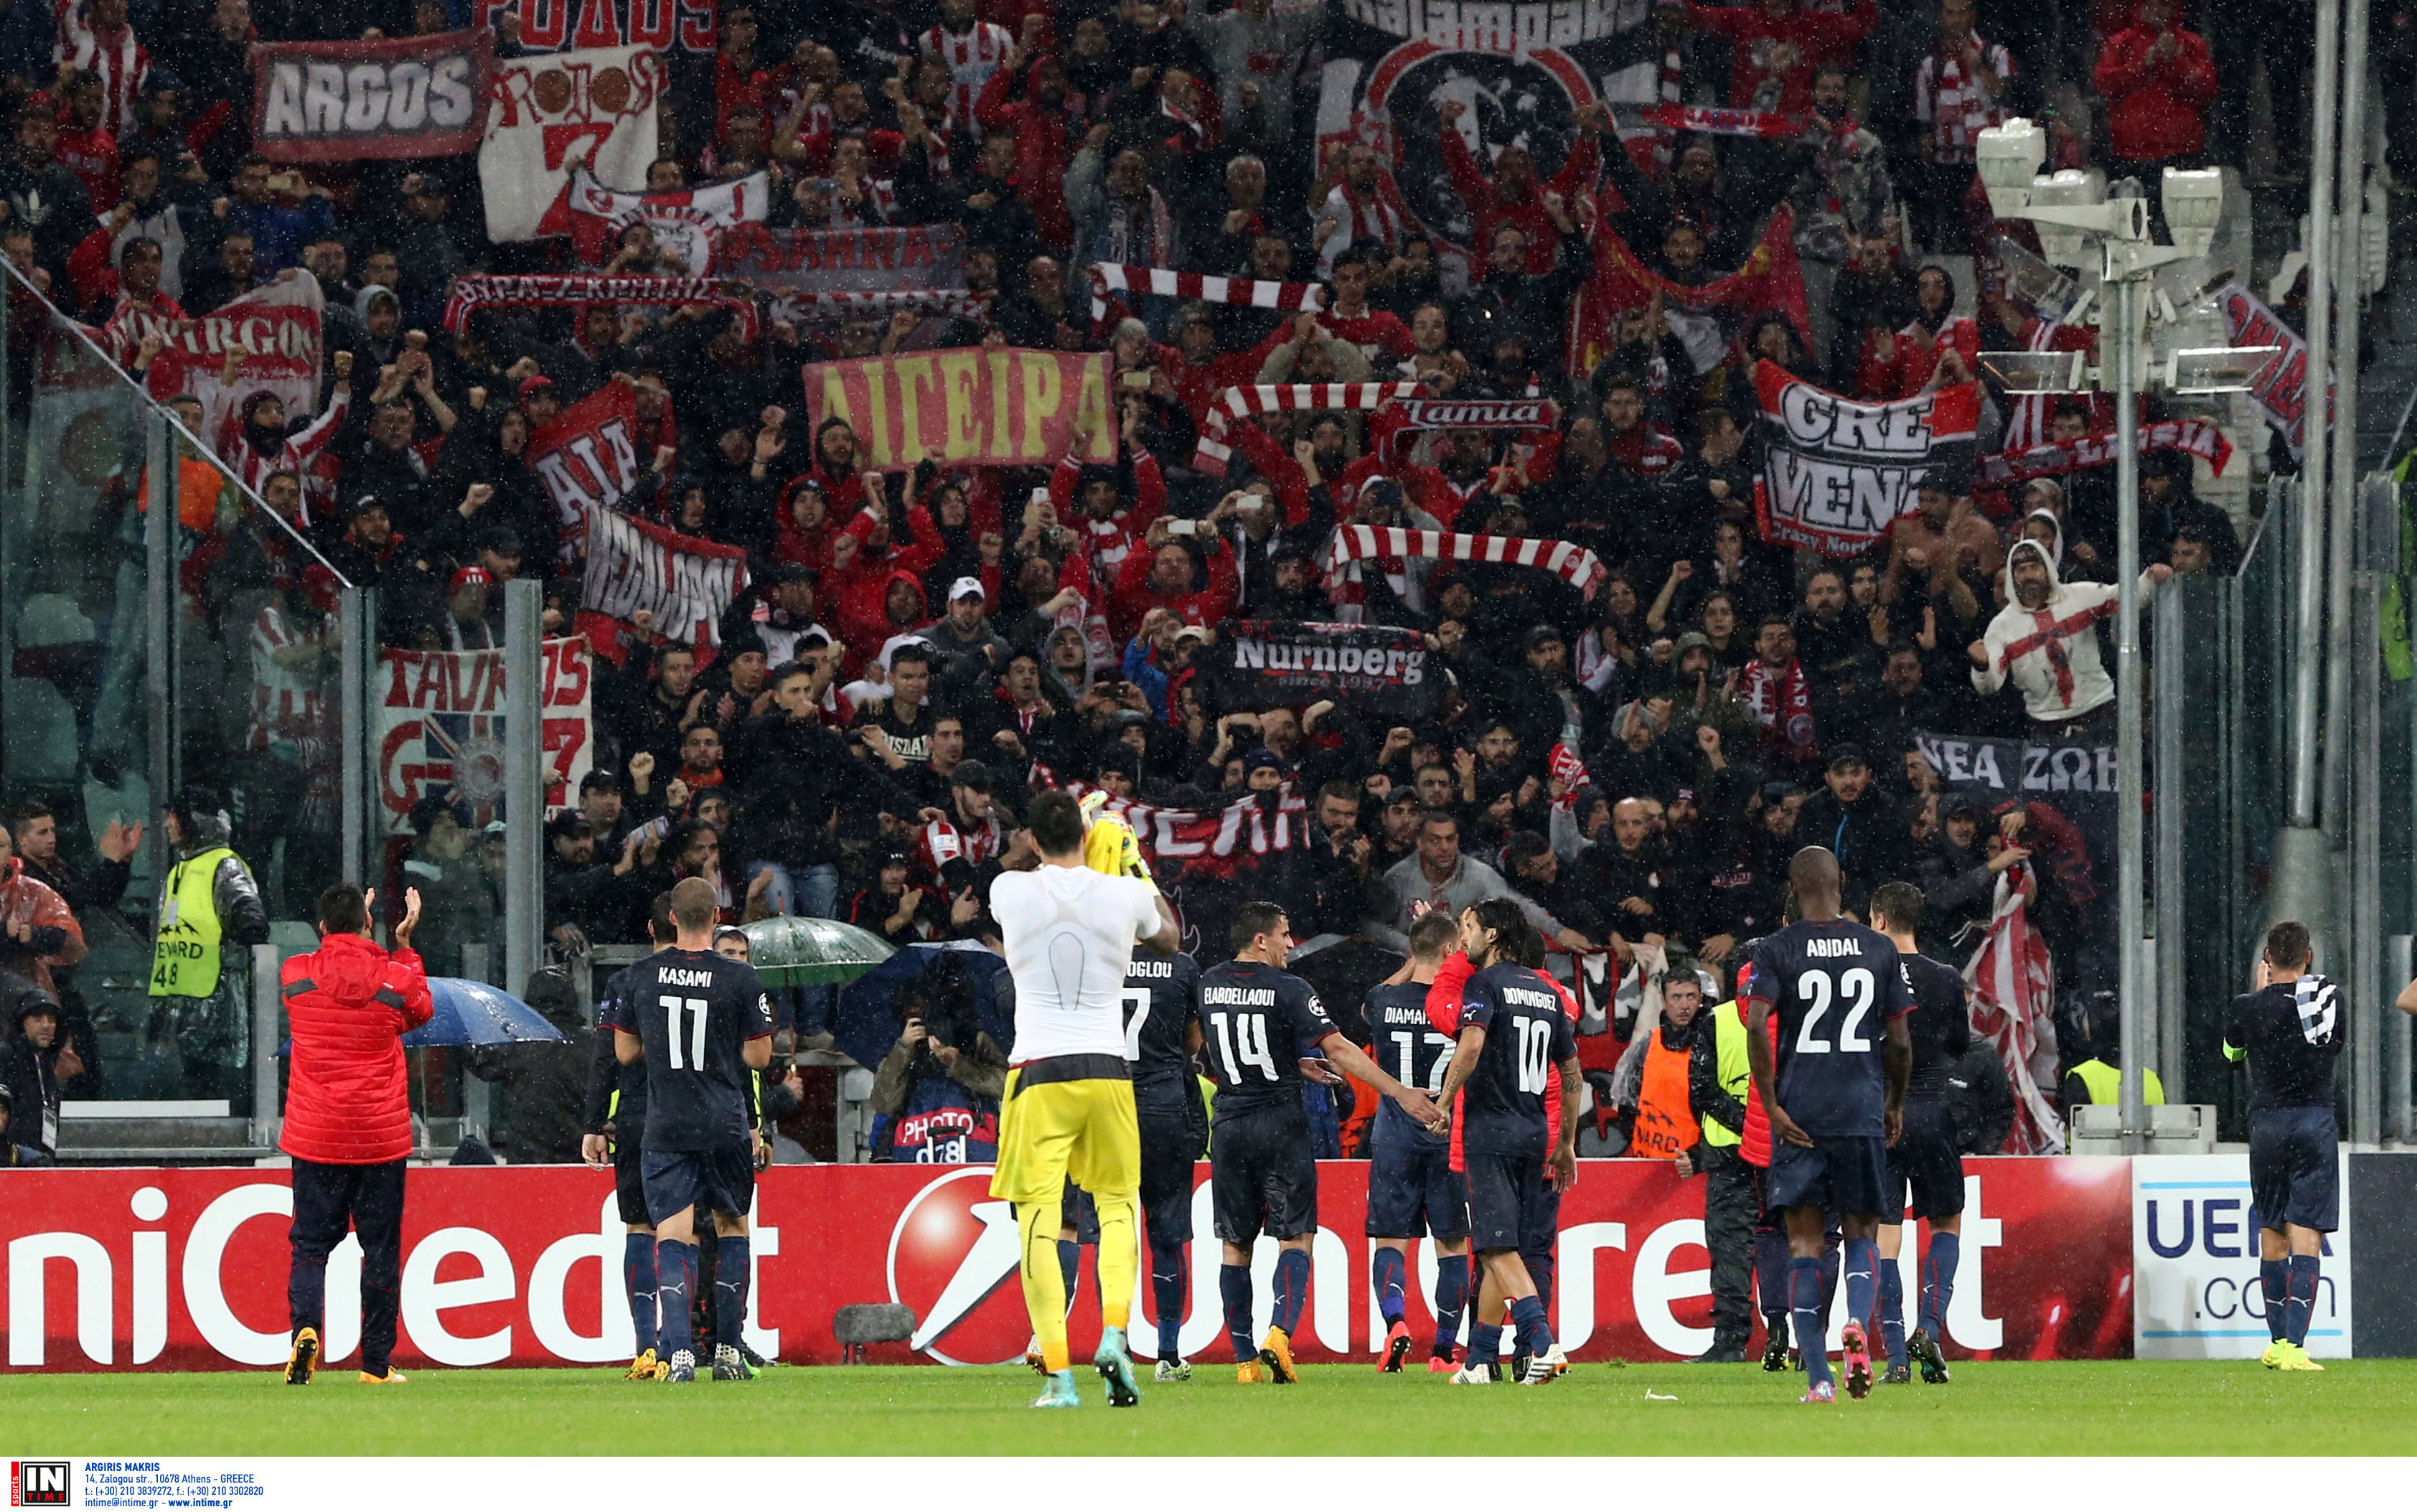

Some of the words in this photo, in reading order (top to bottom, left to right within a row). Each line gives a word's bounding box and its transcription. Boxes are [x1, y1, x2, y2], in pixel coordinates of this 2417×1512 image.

[263, 57, 473, 133] ARGOS
[1403, 399, 1541, 428] Lamia
[1782, 384, 1934, 457] GRE
[543, 718, 586, 805] 7
[154, 962, 178, 987] 48
[658, 967, 713, 988] KASAMI
[1127, 961, 1172, 978] OGLOU
[1807, 938, 1862, 957] ABIDAL
[1122, 987, 1151, 1061] 7
[1204, 987, 1275, 1007] ELABDELLAOUI
[1503, 987, 1557, 1012] DOMINGUEZ
[1796, 968, 1875, 1053] 22
[660, 995, 708, 1071] 11
[1211, 1012, 1280, 1085] 14
[1391, 1031, 1457, 1097] 17
[1513, 1016, 1551, 1095] 10
[903, 1112, 974, 1143] PHOTO
